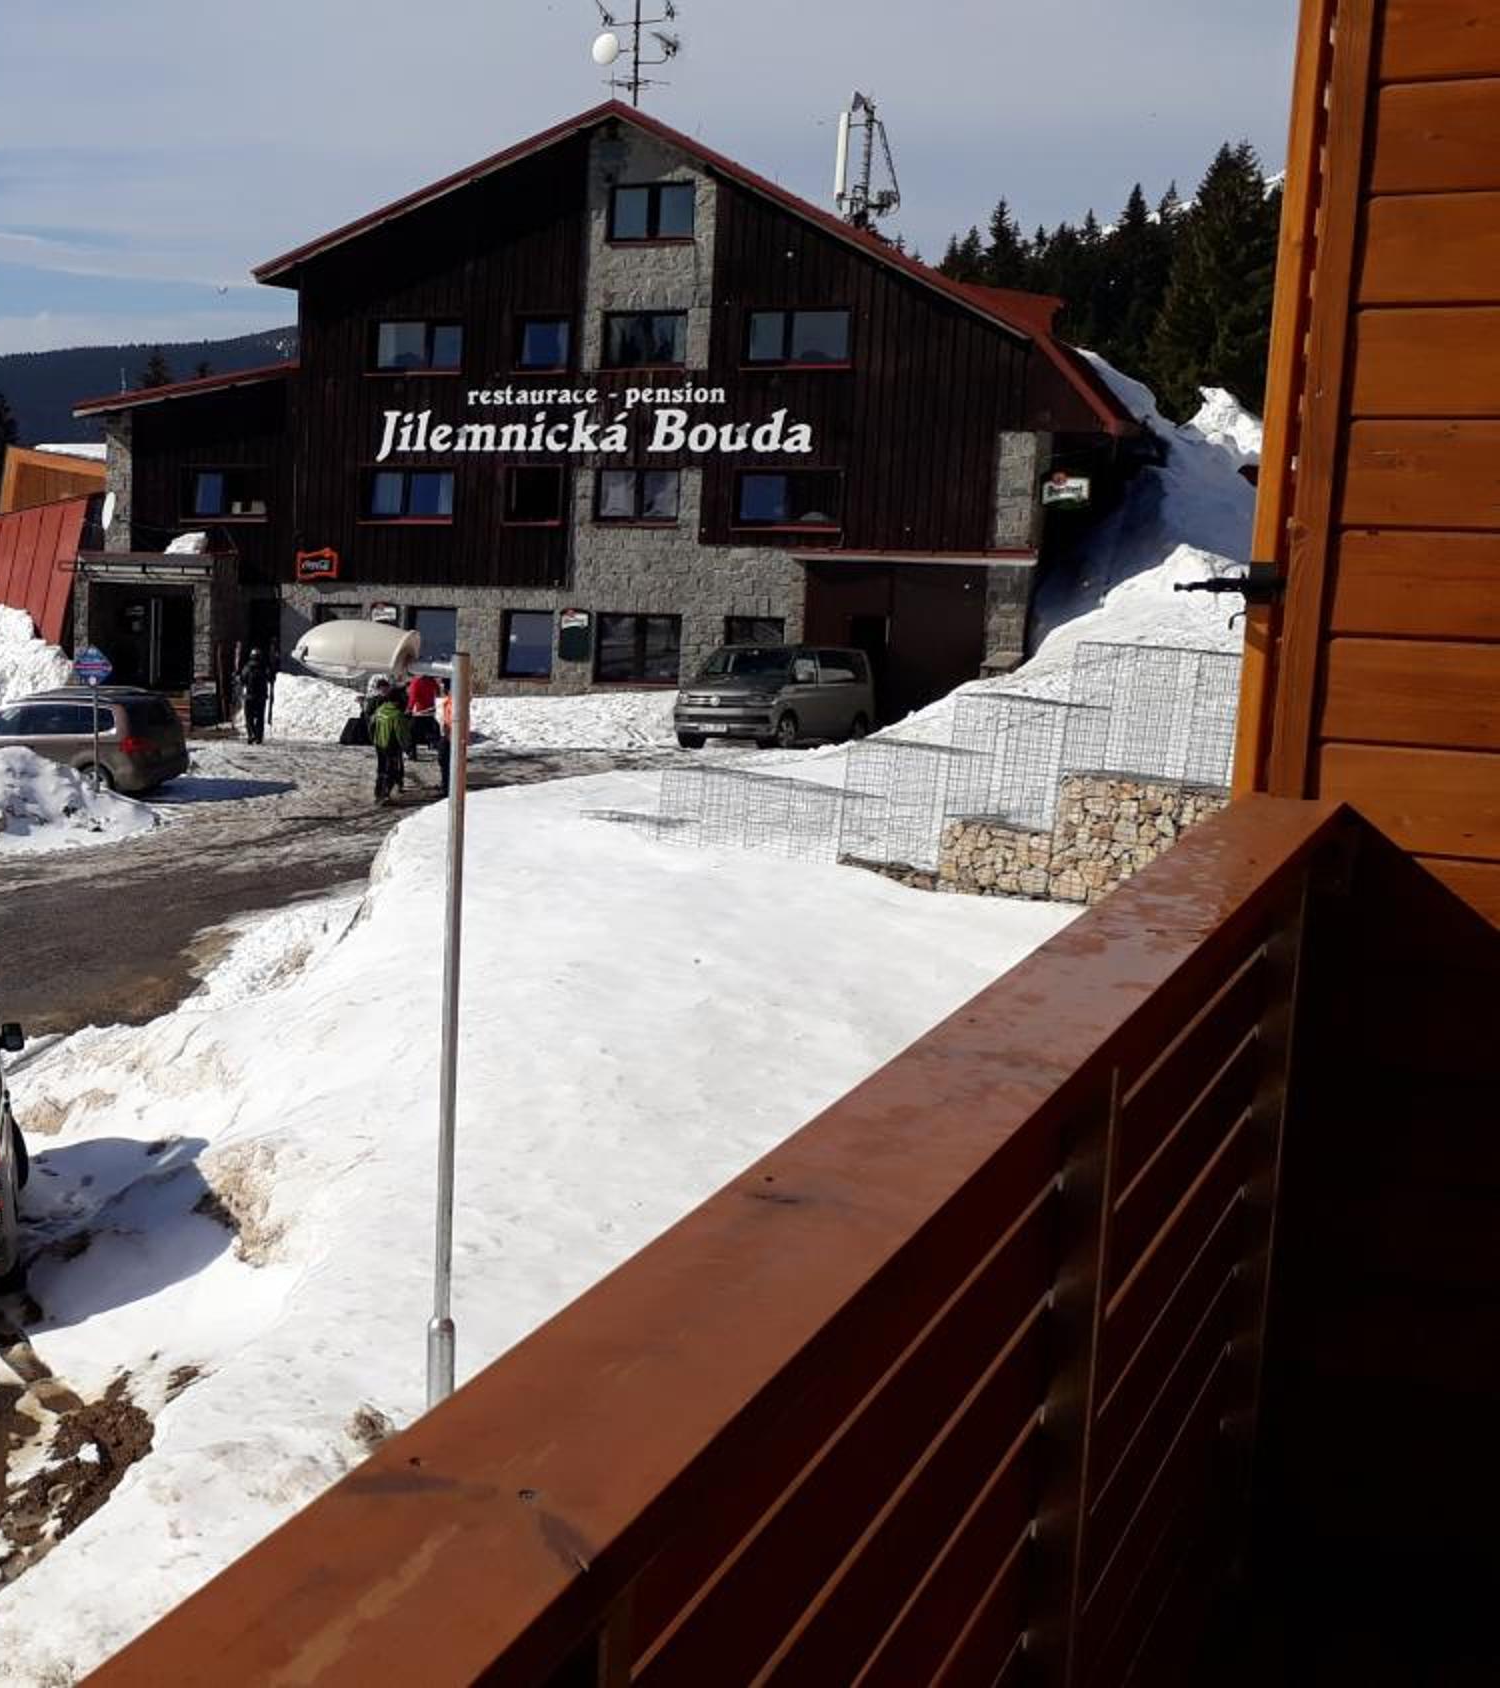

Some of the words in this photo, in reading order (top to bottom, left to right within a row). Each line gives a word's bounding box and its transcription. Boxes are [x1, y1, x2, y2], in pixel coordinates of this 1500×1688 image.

[467, 386, 599, 405] restaurace
[625, 381, 726, 408] pension
[375, 409, 628, 462] Jilemnická
[647, 408, 814, 453] Bouda
